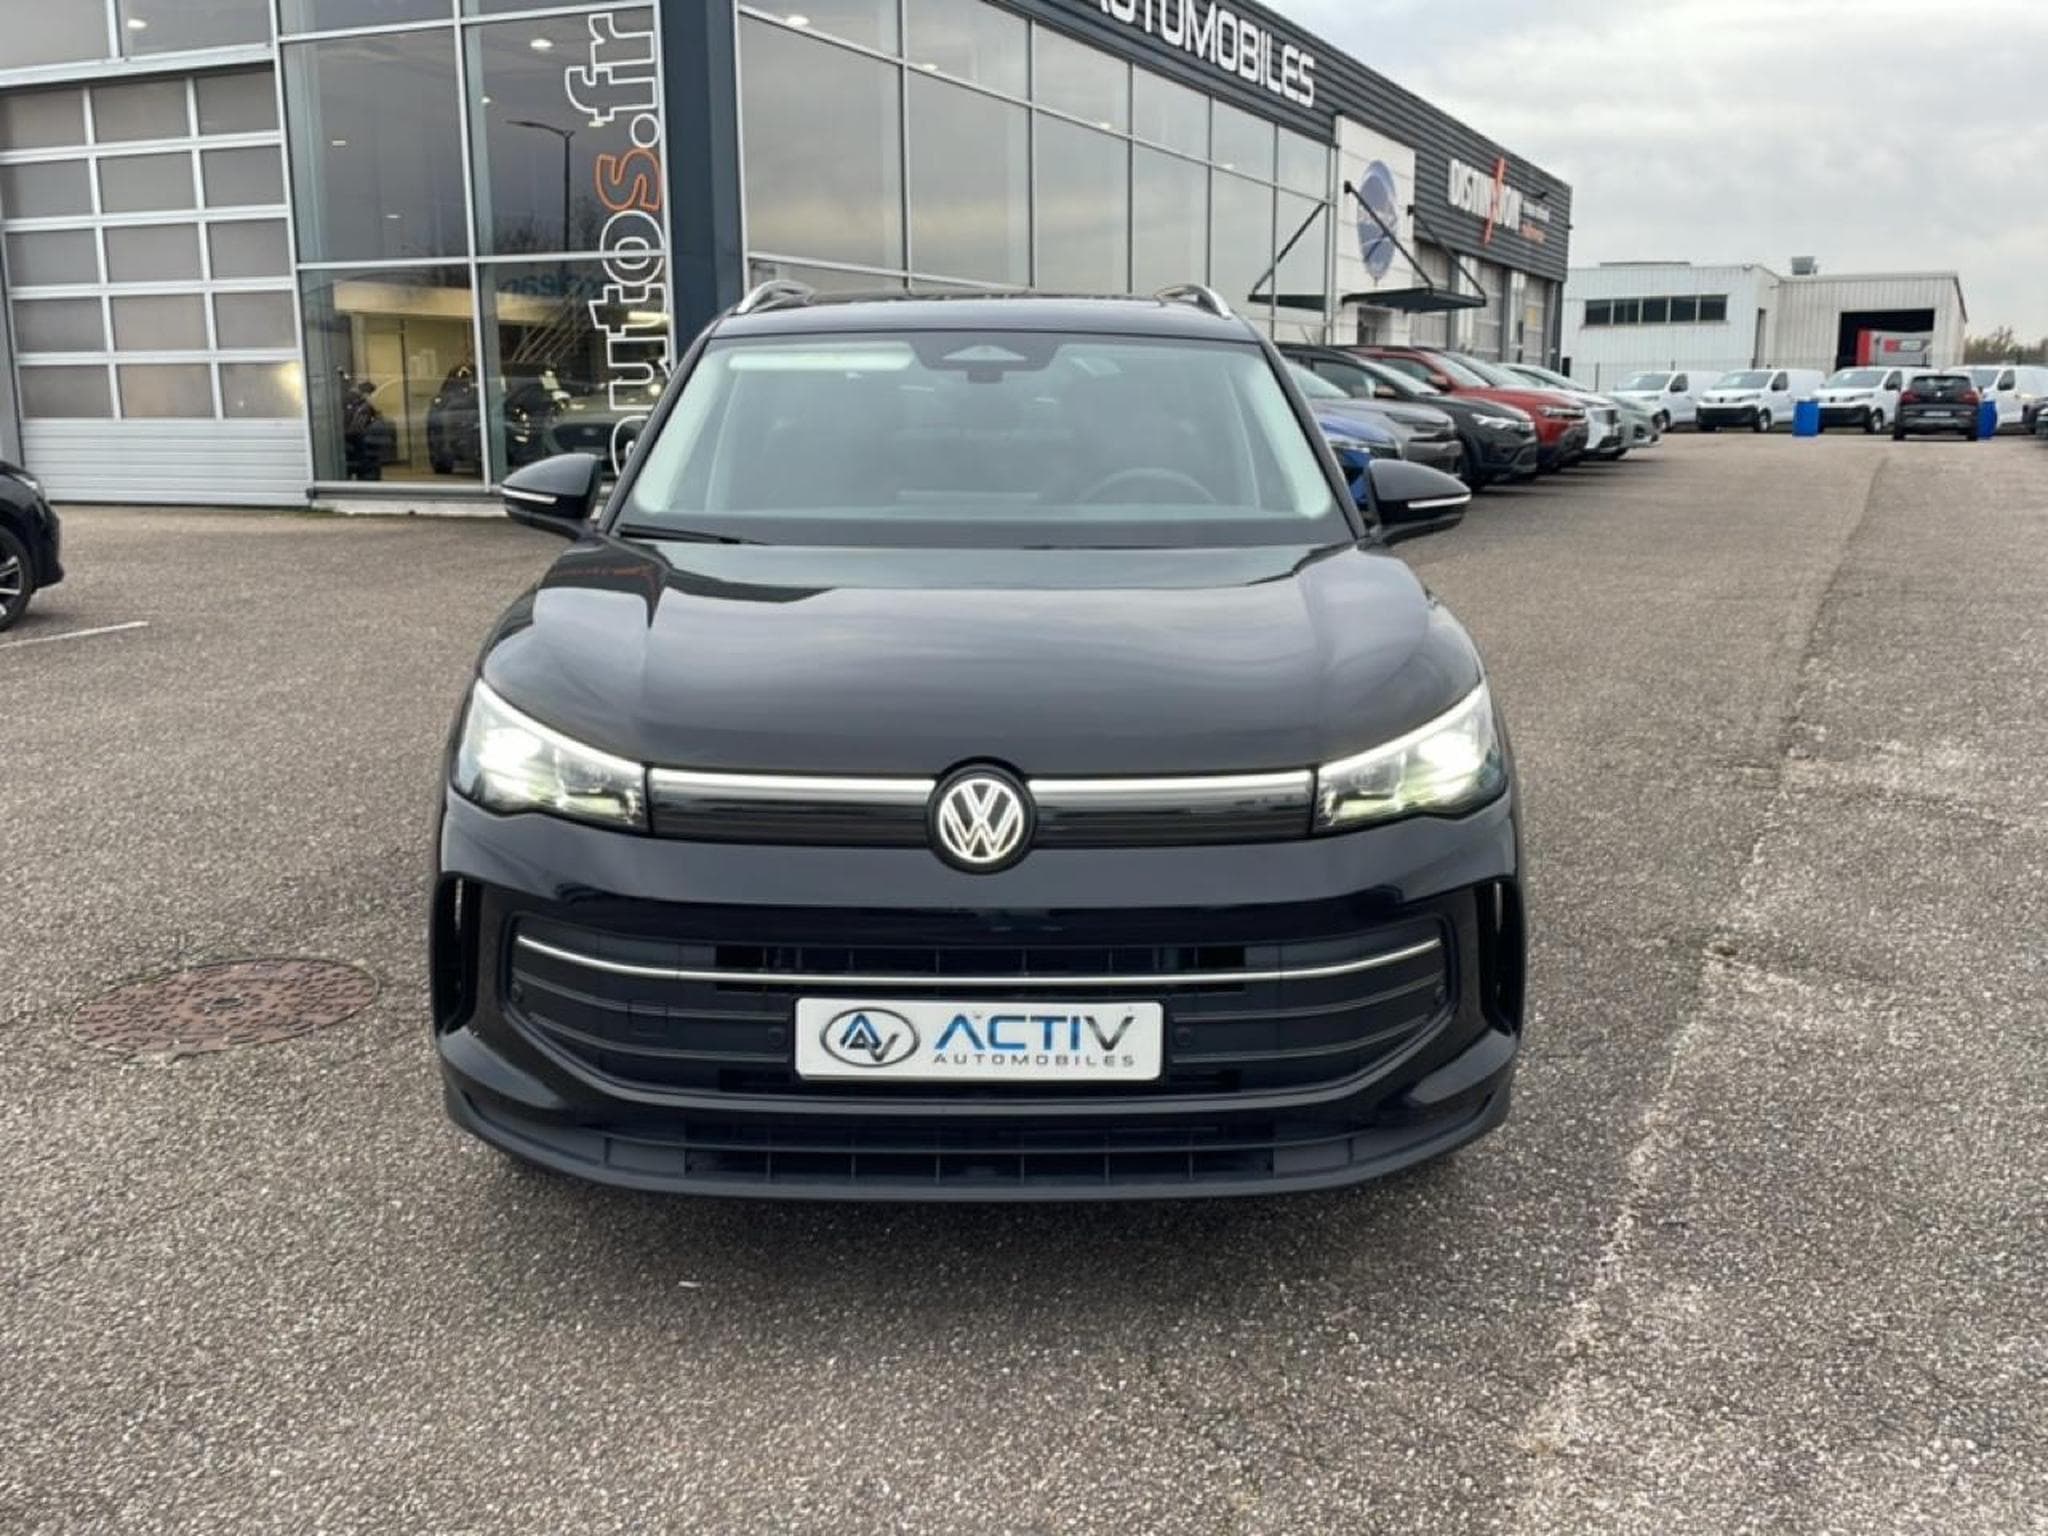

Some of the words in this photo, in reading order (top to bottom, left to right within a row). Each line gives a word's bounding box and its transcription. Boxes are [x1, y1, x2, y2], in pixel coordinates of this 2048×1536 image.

[1100, 0, 1315, 108] OMOBILES
[934, 1013, 1135, 1051] ACTIV
[933, 1053, 1135, 1068] AUTOMOBILES
